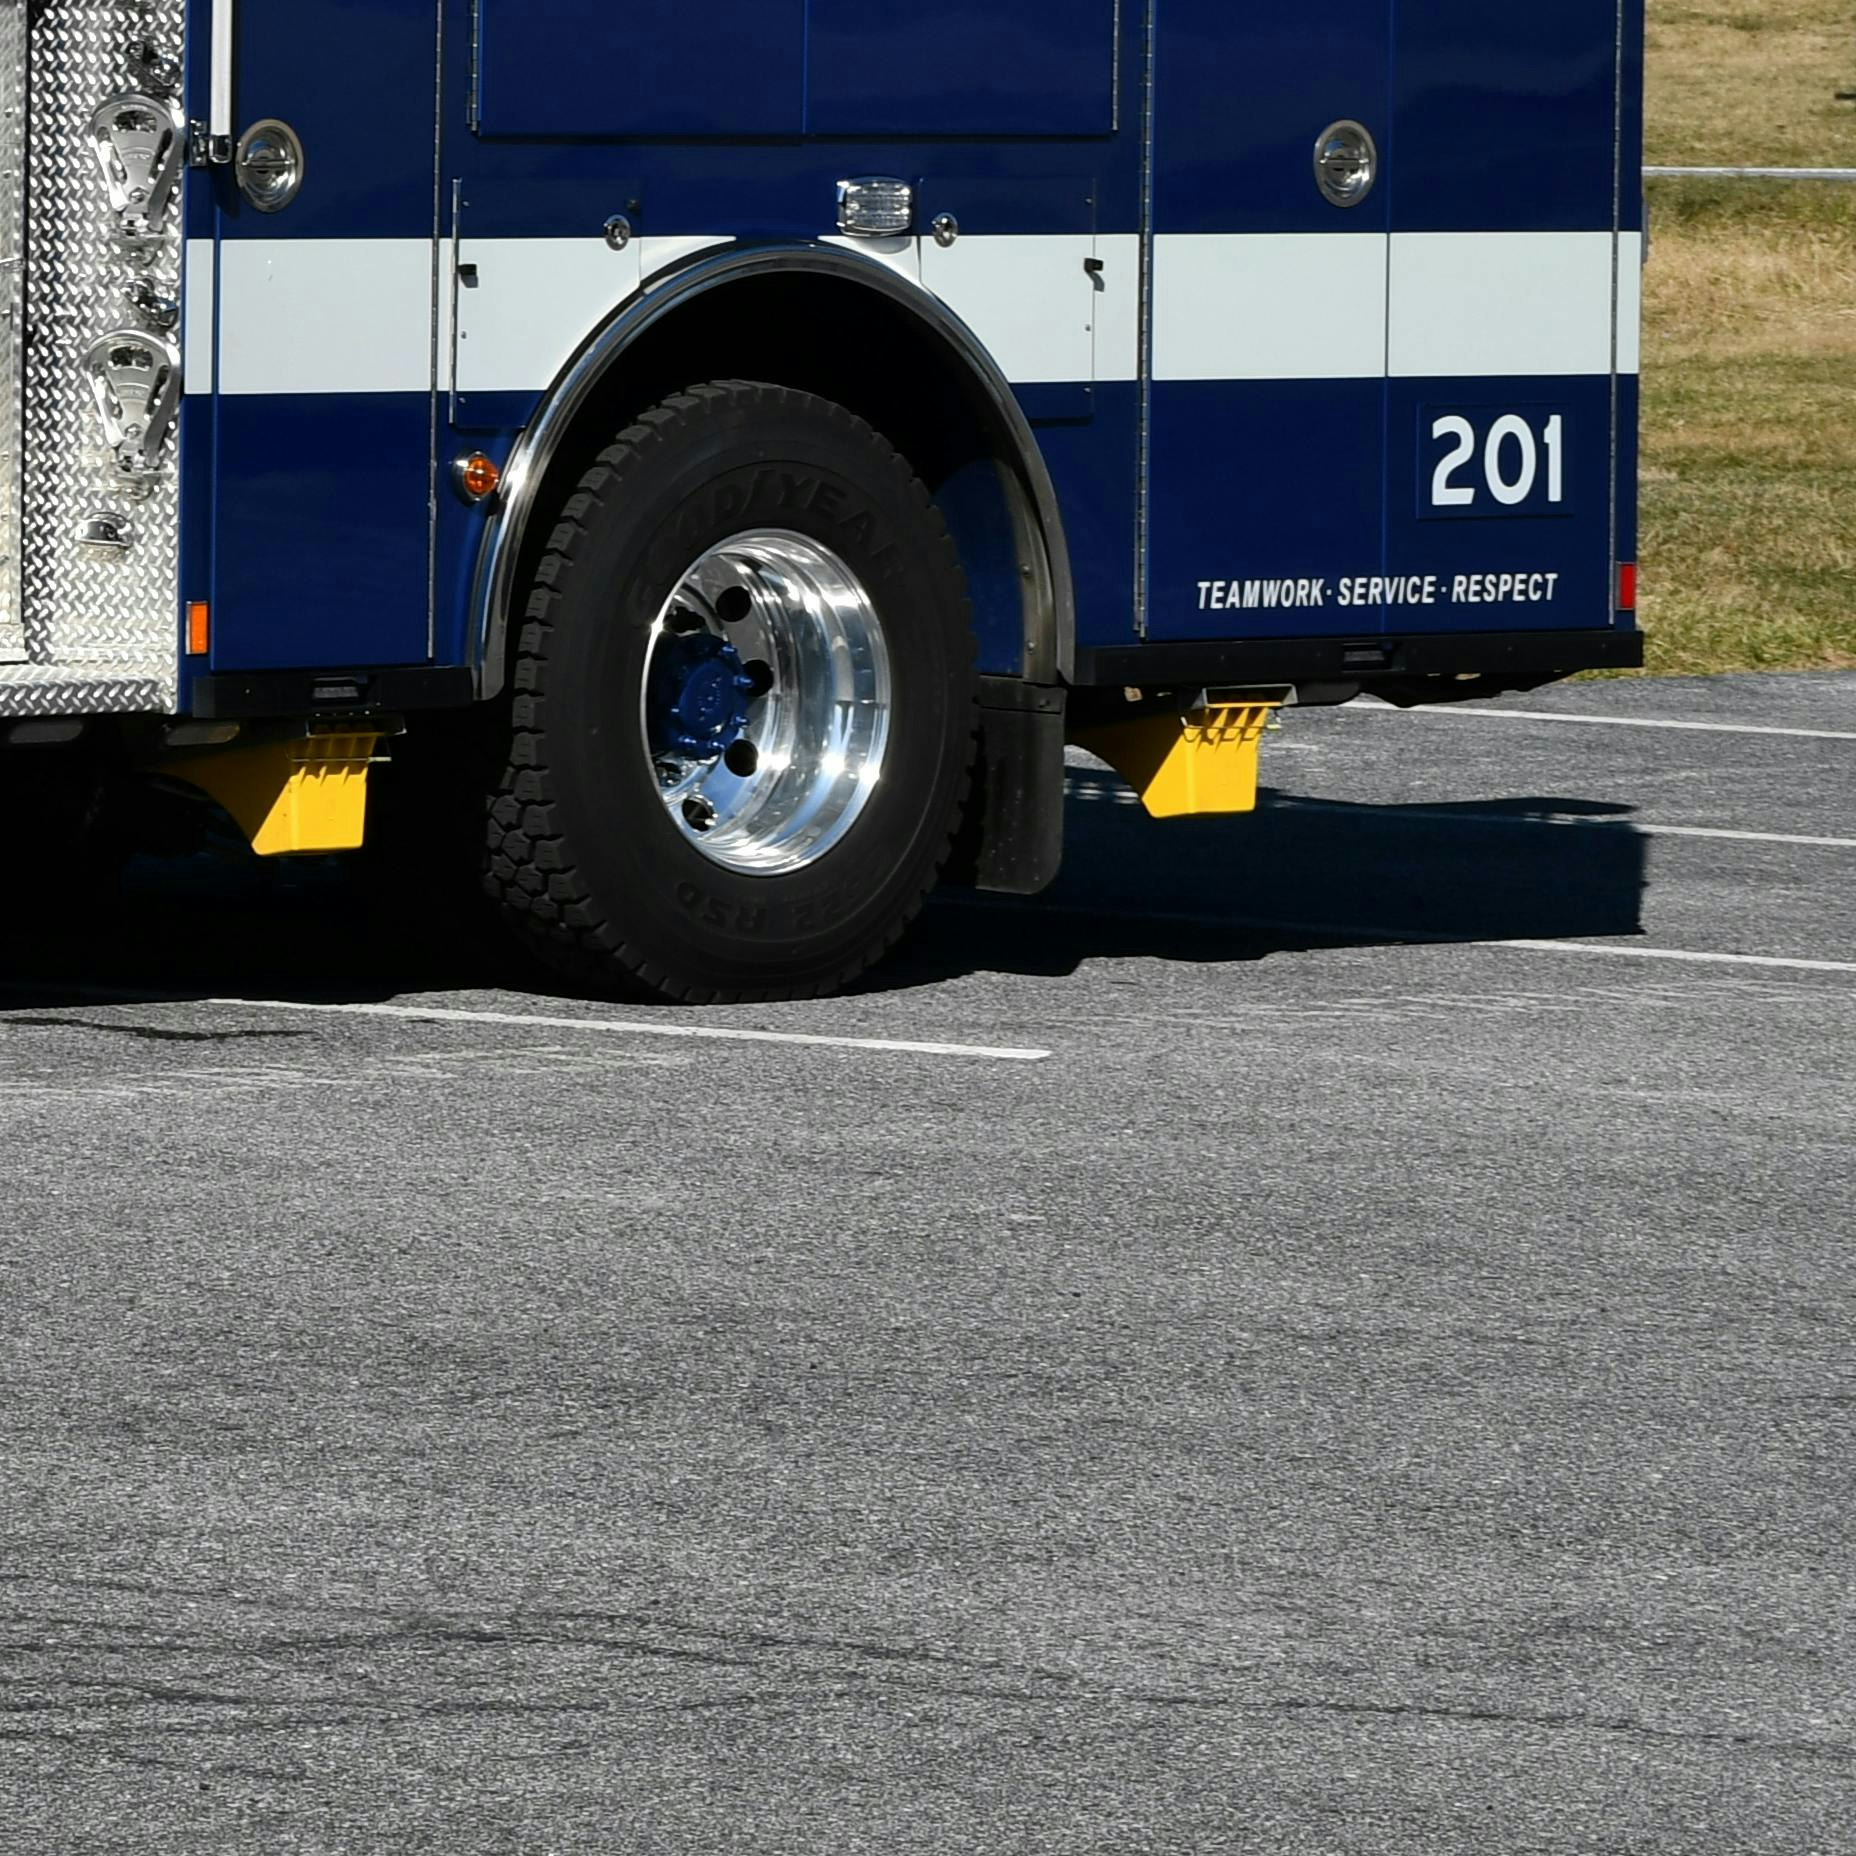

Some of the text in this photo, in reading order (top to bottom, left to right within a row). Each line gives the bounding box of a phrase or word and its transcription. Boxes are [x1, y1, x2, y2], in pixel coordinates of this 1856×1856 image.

[1432, 414, 1562, 506] 201
[1197, 573, 1557, 609] TEAMWORK SERVICE RESPECT
